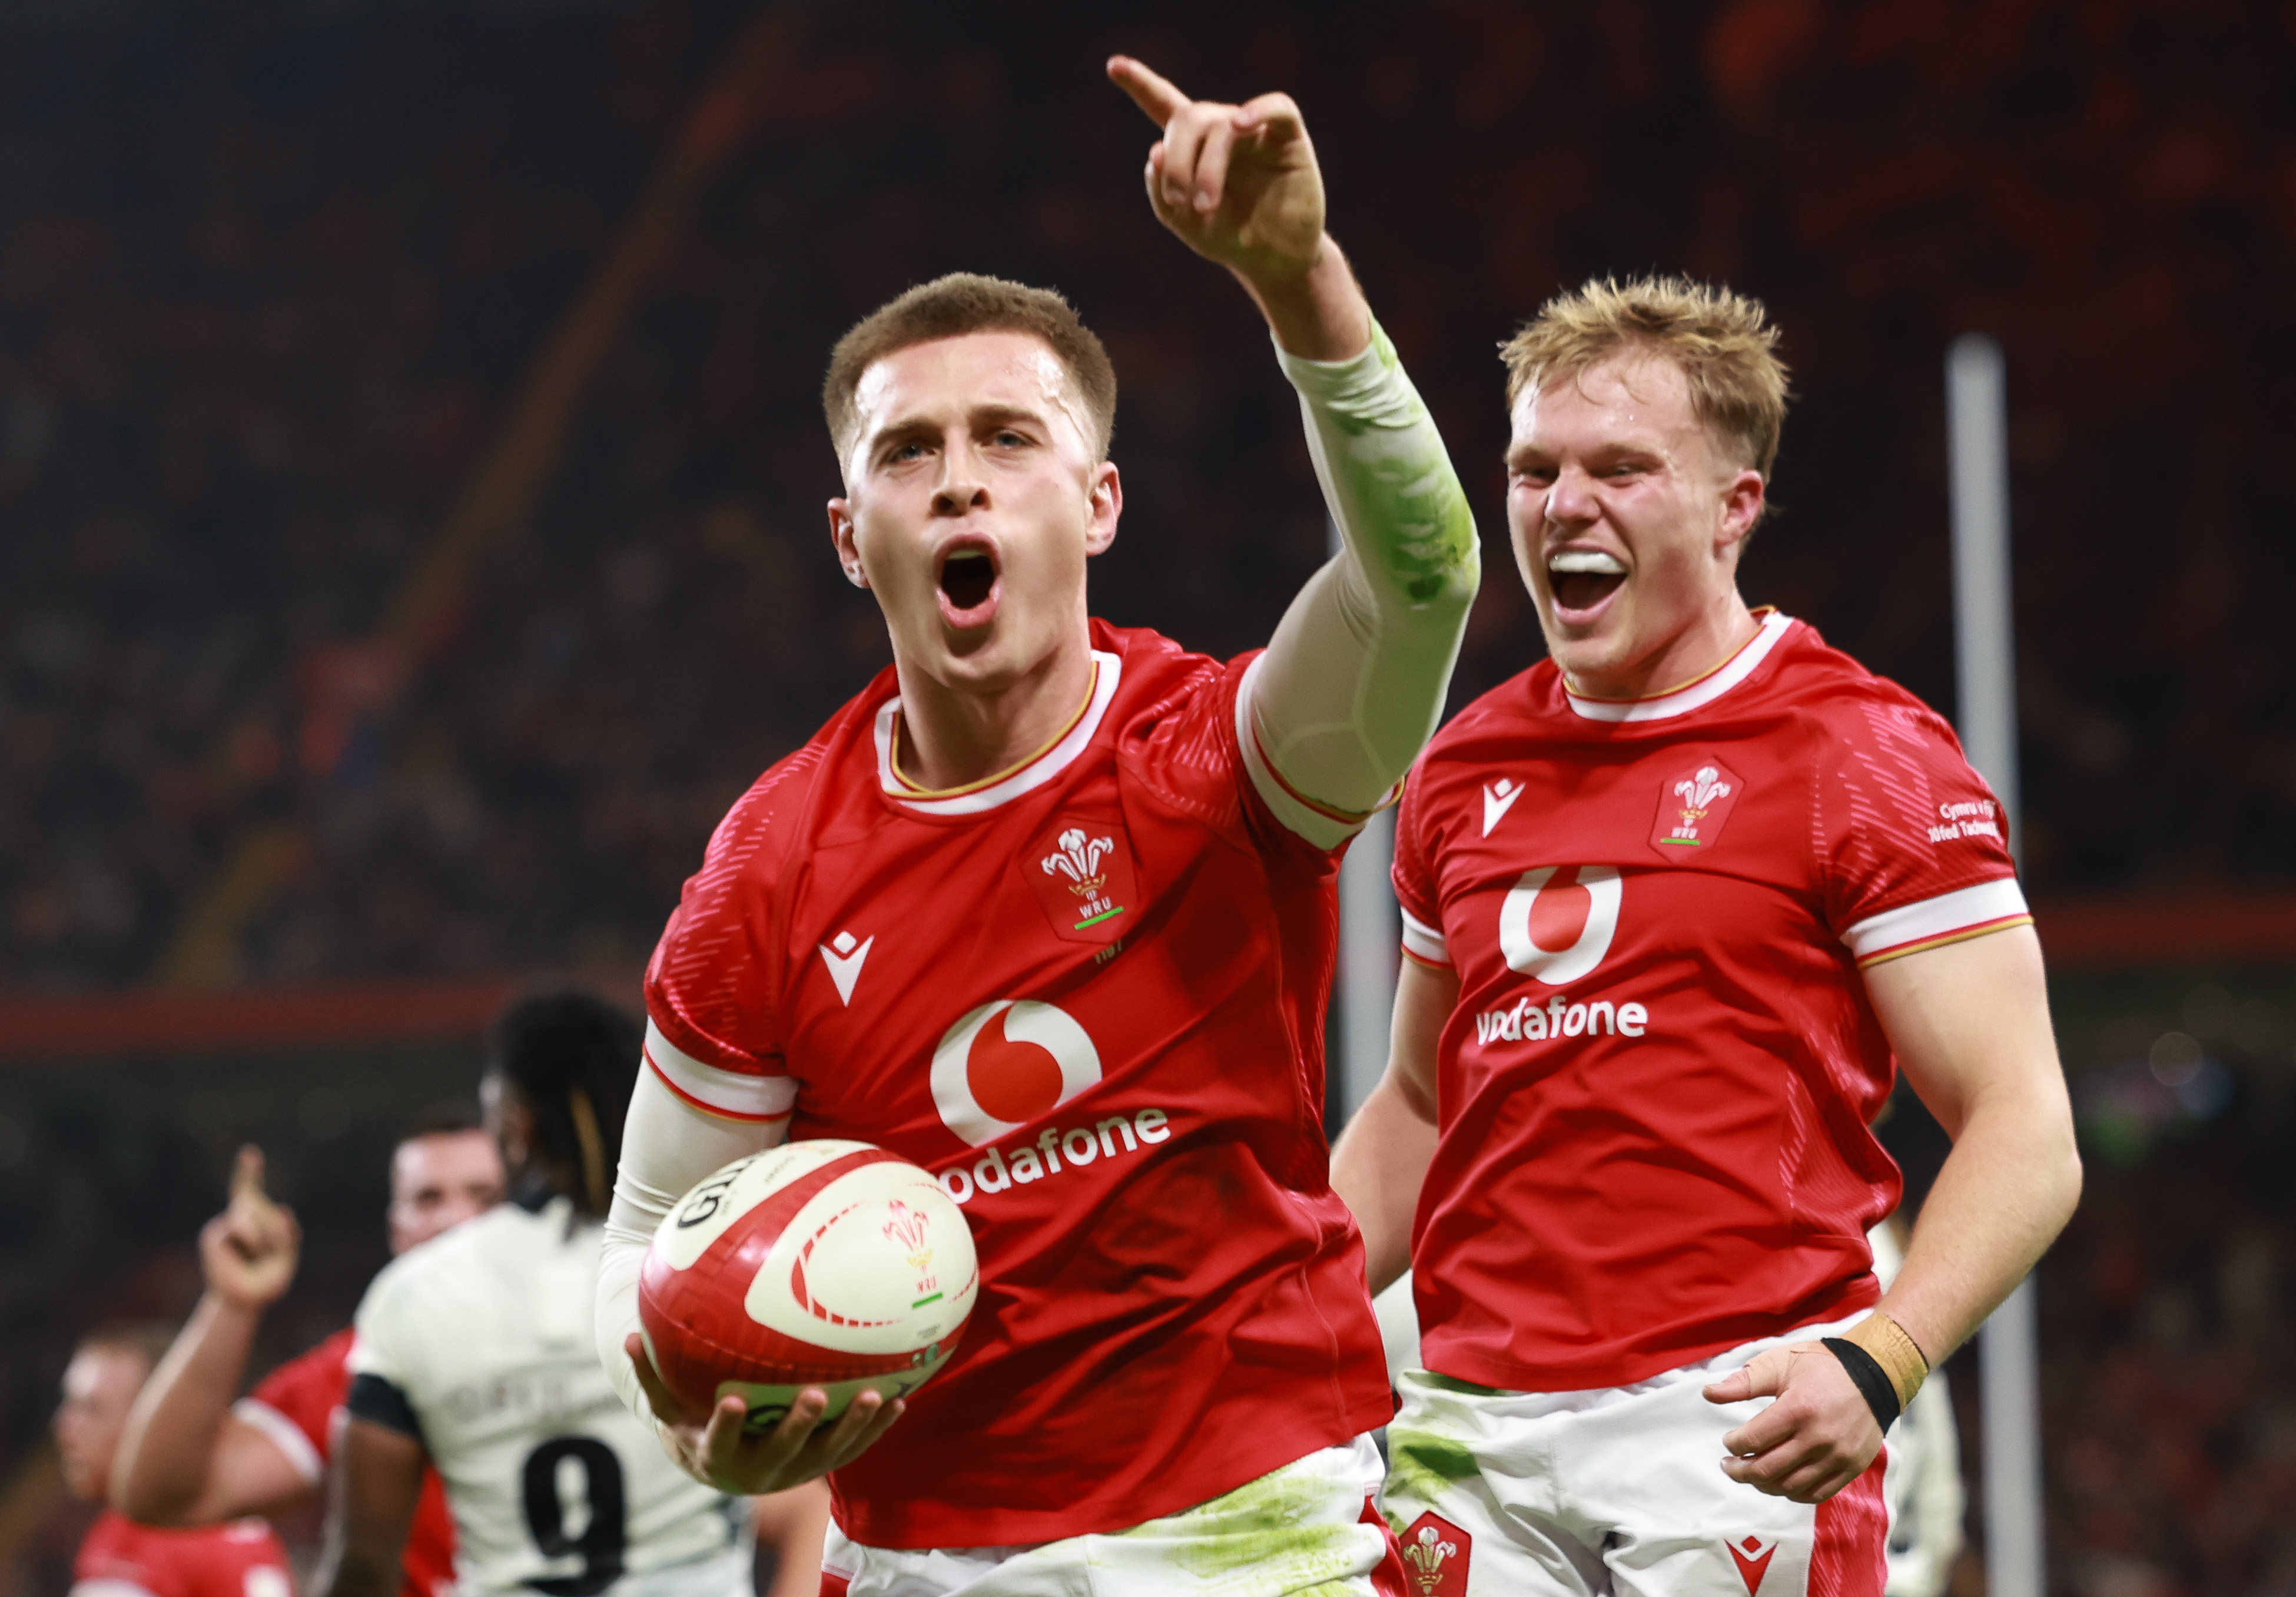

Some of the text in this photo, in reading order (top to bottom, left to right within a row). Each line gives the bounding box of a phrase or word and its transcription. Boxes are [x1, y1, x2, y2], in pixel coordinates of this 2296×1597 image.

[1079, 896, 1112, 918] WRU
[1476, 996, 1648, 1045] vodafone
[938, 1108, 1172, 1205] odafone
[520, 1436, 626, 1597] 9
